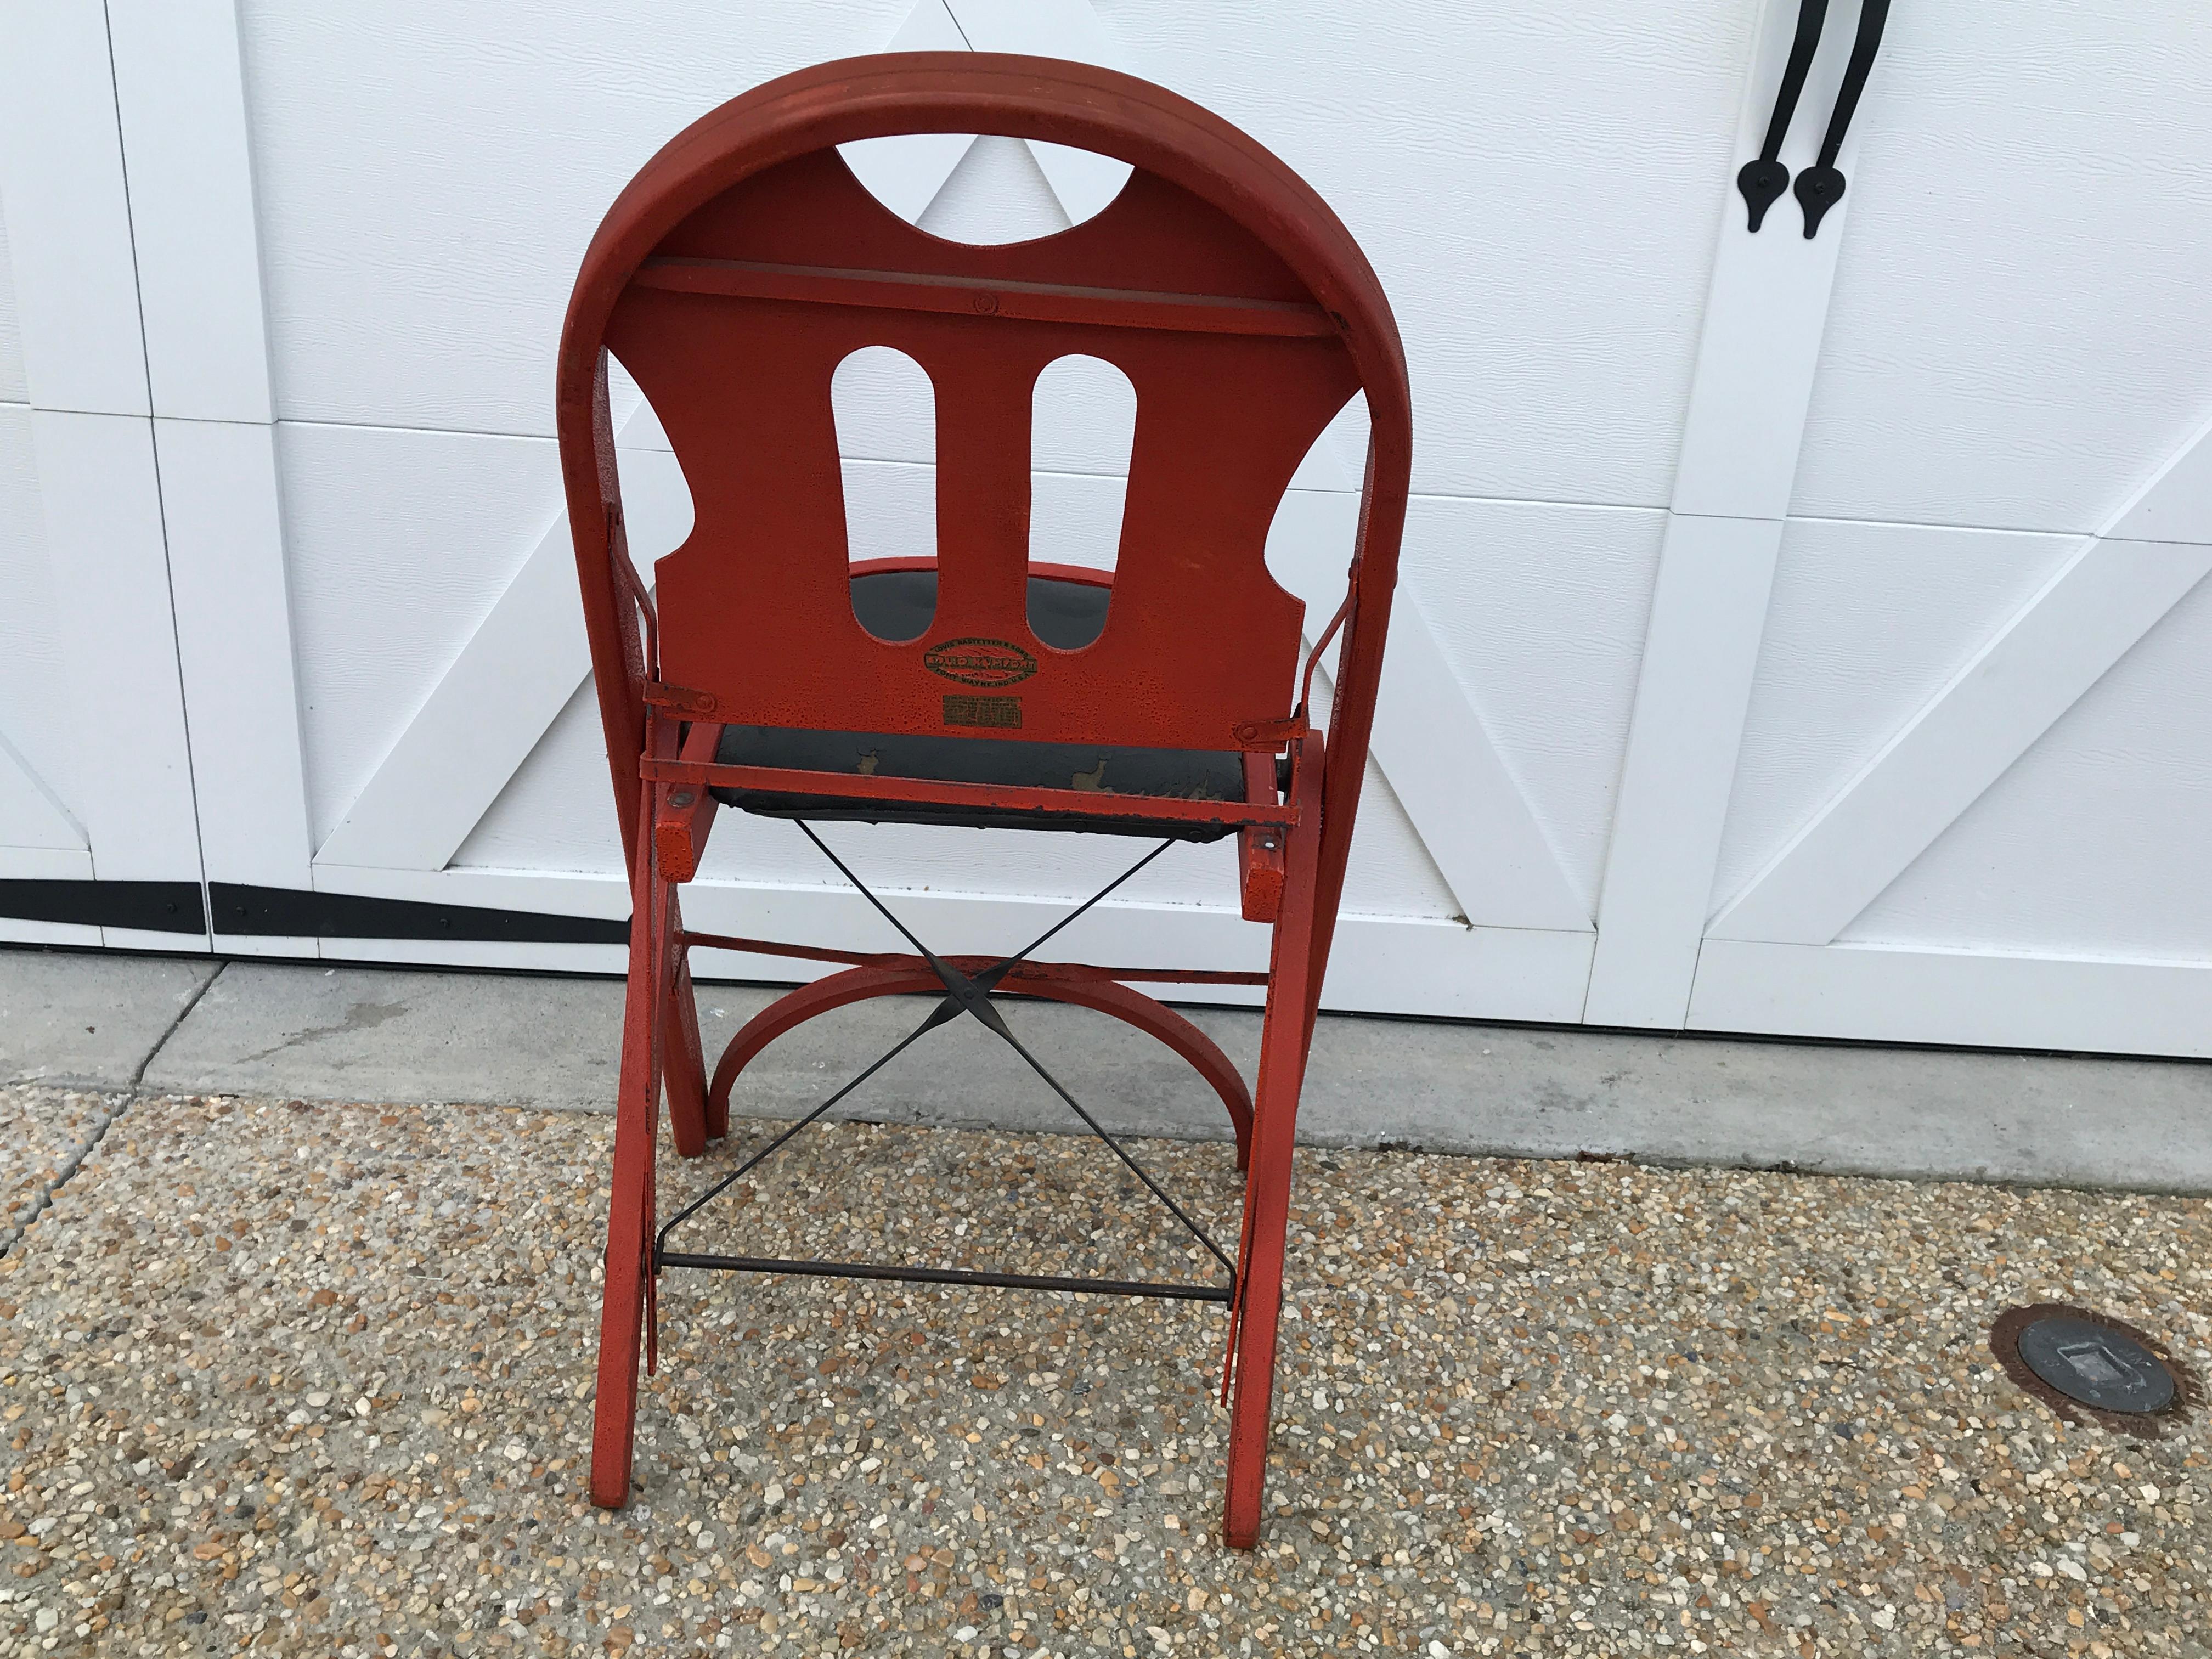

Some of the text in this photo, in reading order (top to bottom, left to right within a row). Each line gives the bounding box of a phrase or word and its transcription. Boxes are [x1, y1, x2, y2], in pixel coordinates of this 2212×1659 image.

[934, 642, 955, 652] LOUIS
[1012, 645, 1029, 658] SONS
[935, 668, 959, 680] FORT
[961, 677, 993, 687] WAYNE
